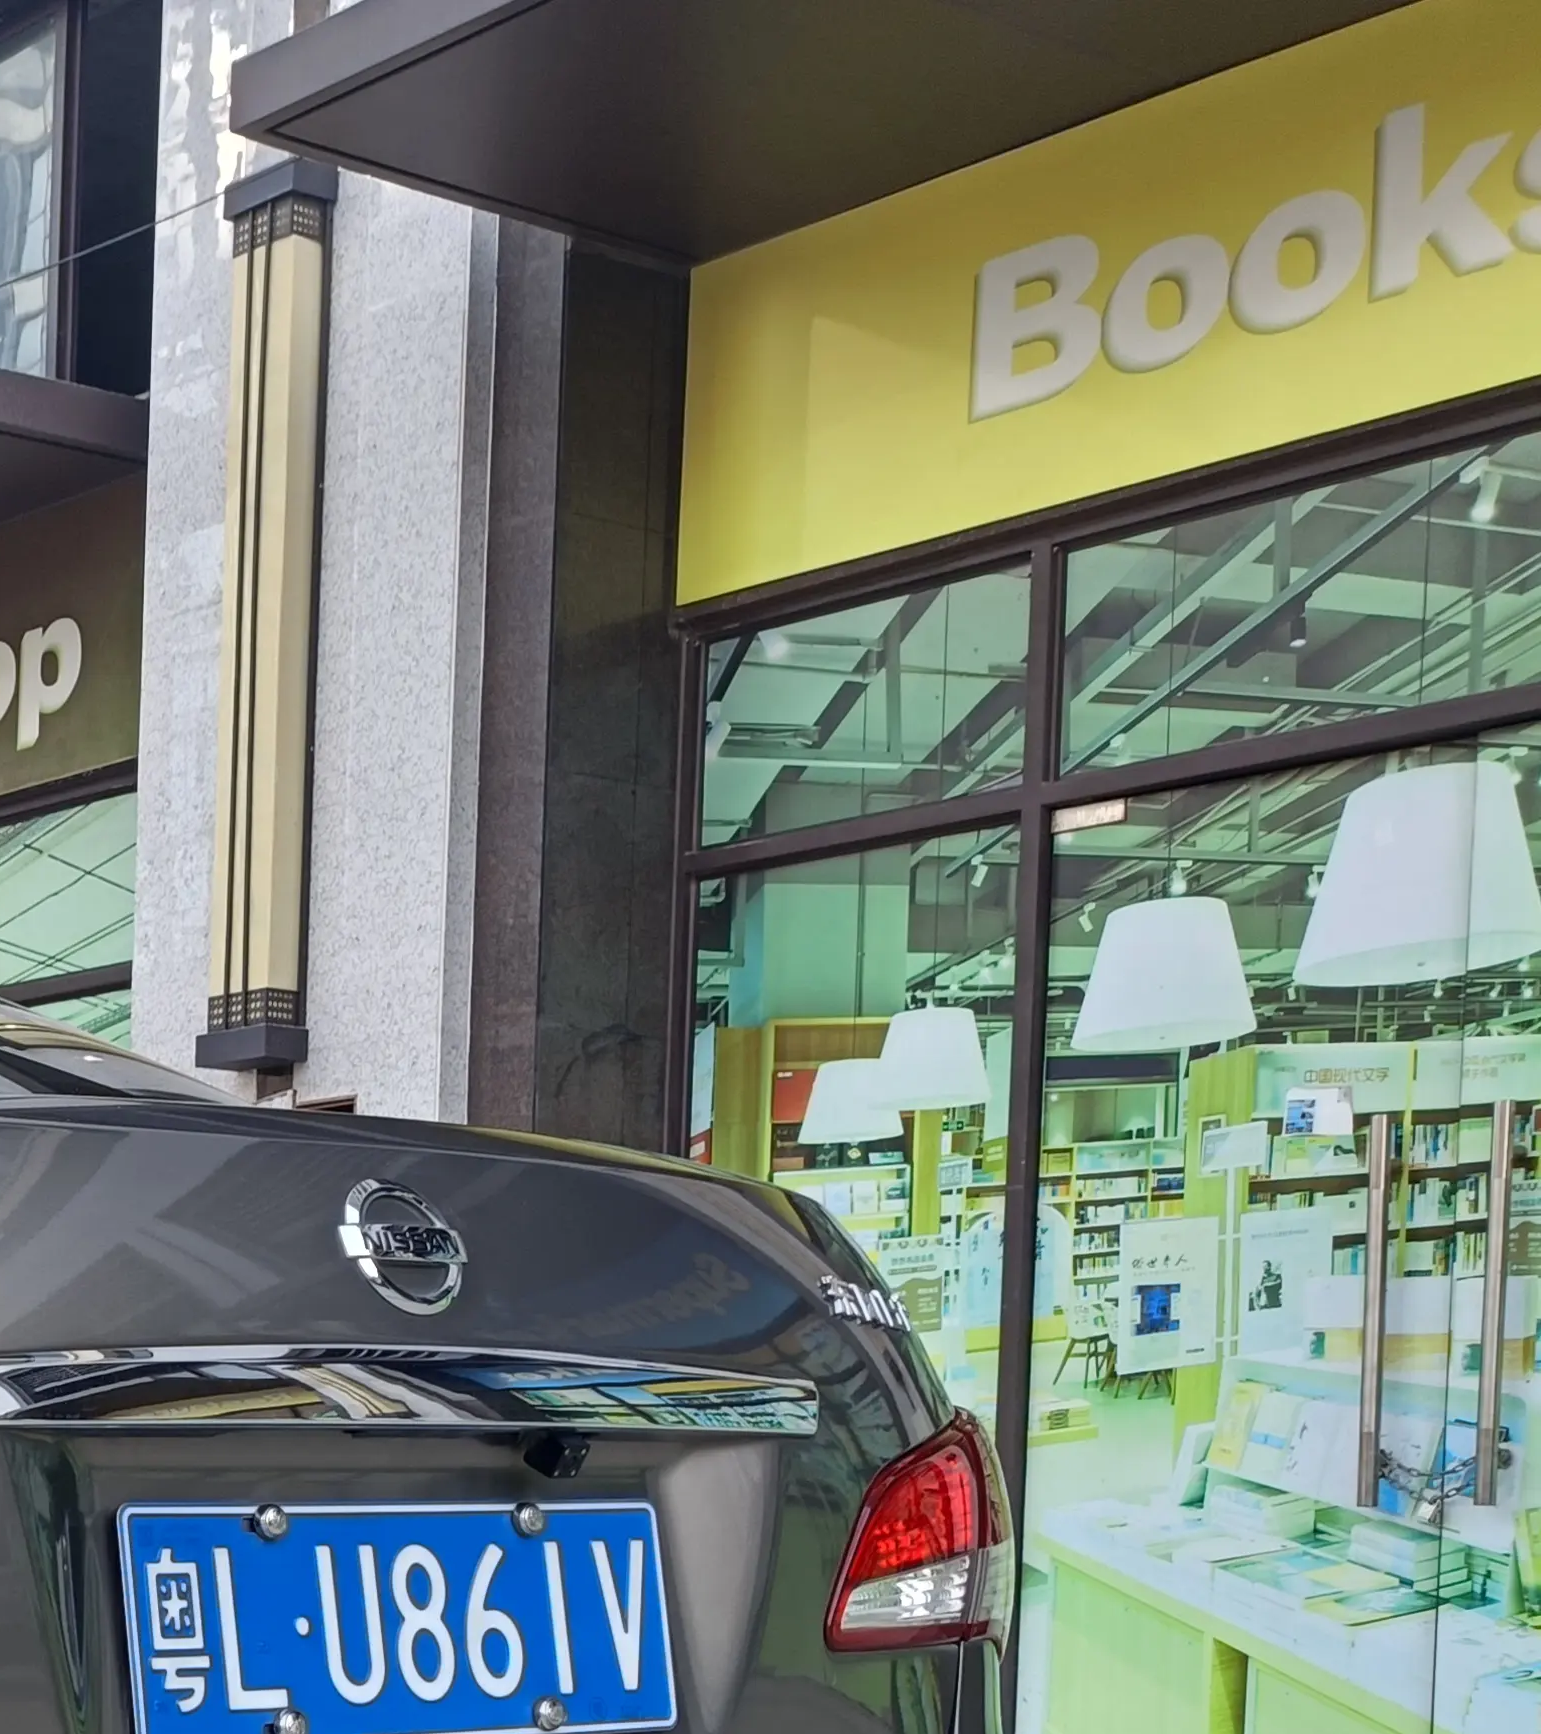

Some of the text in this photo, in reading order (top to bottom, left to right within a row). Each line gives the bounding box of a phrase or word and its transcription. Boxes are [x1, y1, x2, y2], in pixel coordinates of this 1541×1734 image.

[969, 102, 1540, 423] Book
[1303, 1066, 1390, 1084] 中国现代文学
[365, 1226, 462, 1257] NISSAN
[145, 1539, 645, 1714] 粤L·U861V
